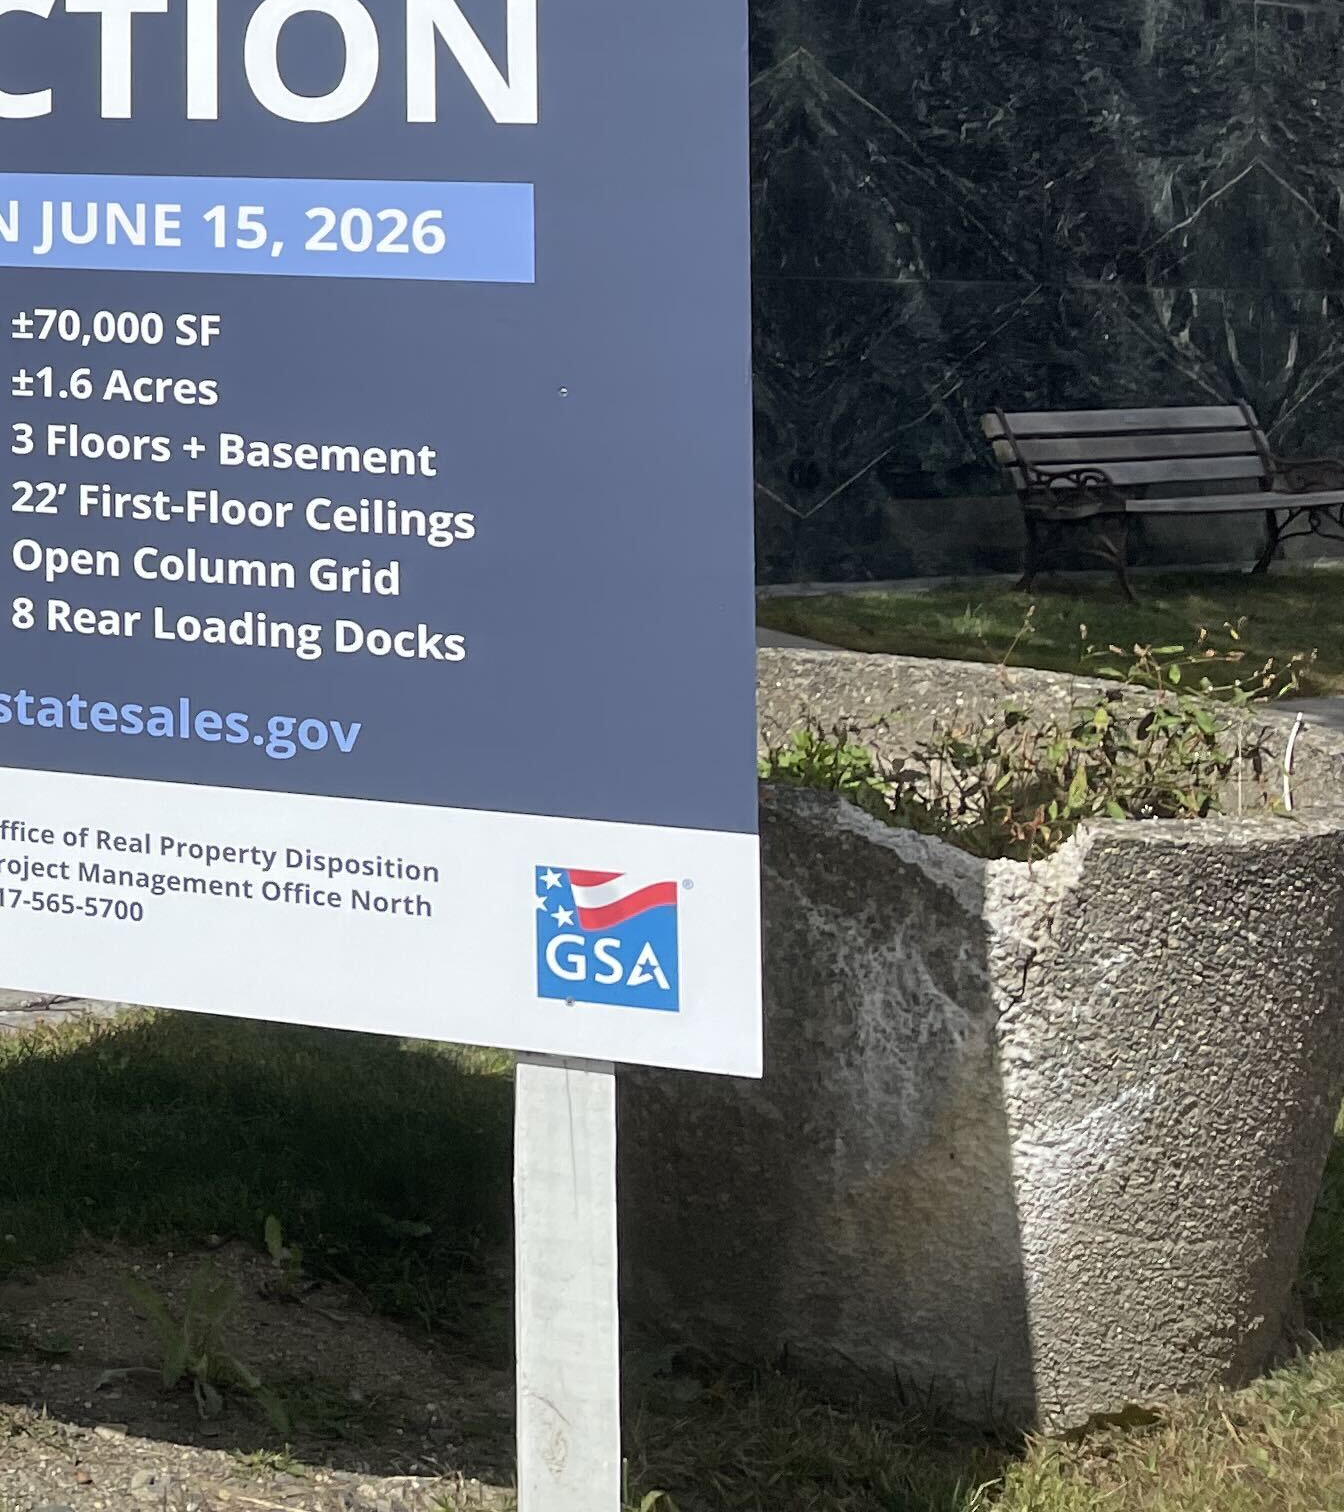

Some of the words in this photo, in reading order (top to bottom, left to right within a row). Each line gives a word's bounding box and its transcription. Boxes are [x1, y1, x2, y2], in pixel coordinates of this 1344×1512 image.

[32, 200, 182, 255] JUNE
[202, 205, 284, 257] 15,
[304, 206, 446, 255] 2026
[11, 308, 164, 347] ±70,000
[175, 314, 221, 347] SF
[11, 366, 93, 400] ±1.6
[102, 369, 218, 406] Acres
[11, 422, 34, 455] 3
[47, 423, 171, 462] Floors
[182, 436, 206, 459] +
[219, 433, 437, 477] Basement
[80, 484, 294, 528] First-Floor
[305, 497, 475, 548] Ceilings
[12, 539, 120, 582] Open
[133, 546, 295, 589] Column
[309, 558, 400, 596] Grid
[11, 597, 35, 630] 8
[47, 599, 141, 637] Rear
[154, 606, 322, 660] Loading
[335, 619, 466, 662] Docks
[63, 827, 90, 848] of
[96, 829, 151, 855] Real
[160, 835, 277, 873] Property
[286, 847, 439, 883] Disposition
[78, 861, 253, 899] Management
[261, 880, 342, 908] Office
[351, 889, 432, 917] North
[545, 934, 670, 989] GSA
